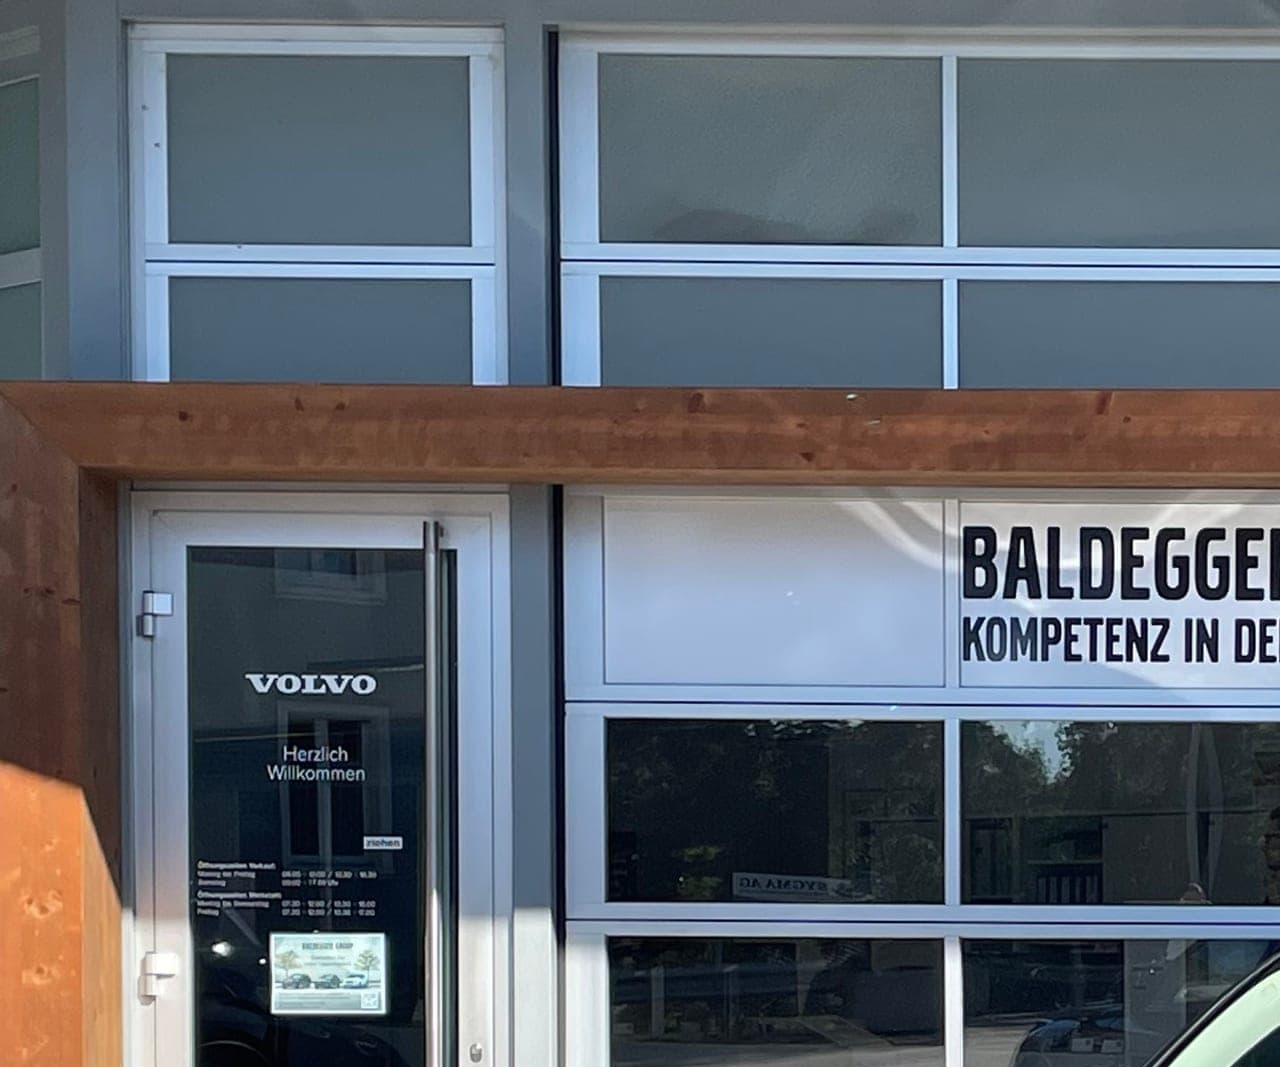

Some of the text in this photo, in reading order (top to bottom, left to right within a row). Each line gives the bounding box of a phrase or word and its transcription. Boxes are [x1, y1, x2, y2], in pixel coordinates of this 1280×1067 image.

[962, 616, 1170, 663] KOMPETENZ
[1184, 618, 1218, 664] IN
[245, 674, 377, 695] VOLVO
[283, 746, 349, 763] Herzlich
[267, 764, 366, 782] Willkommen
